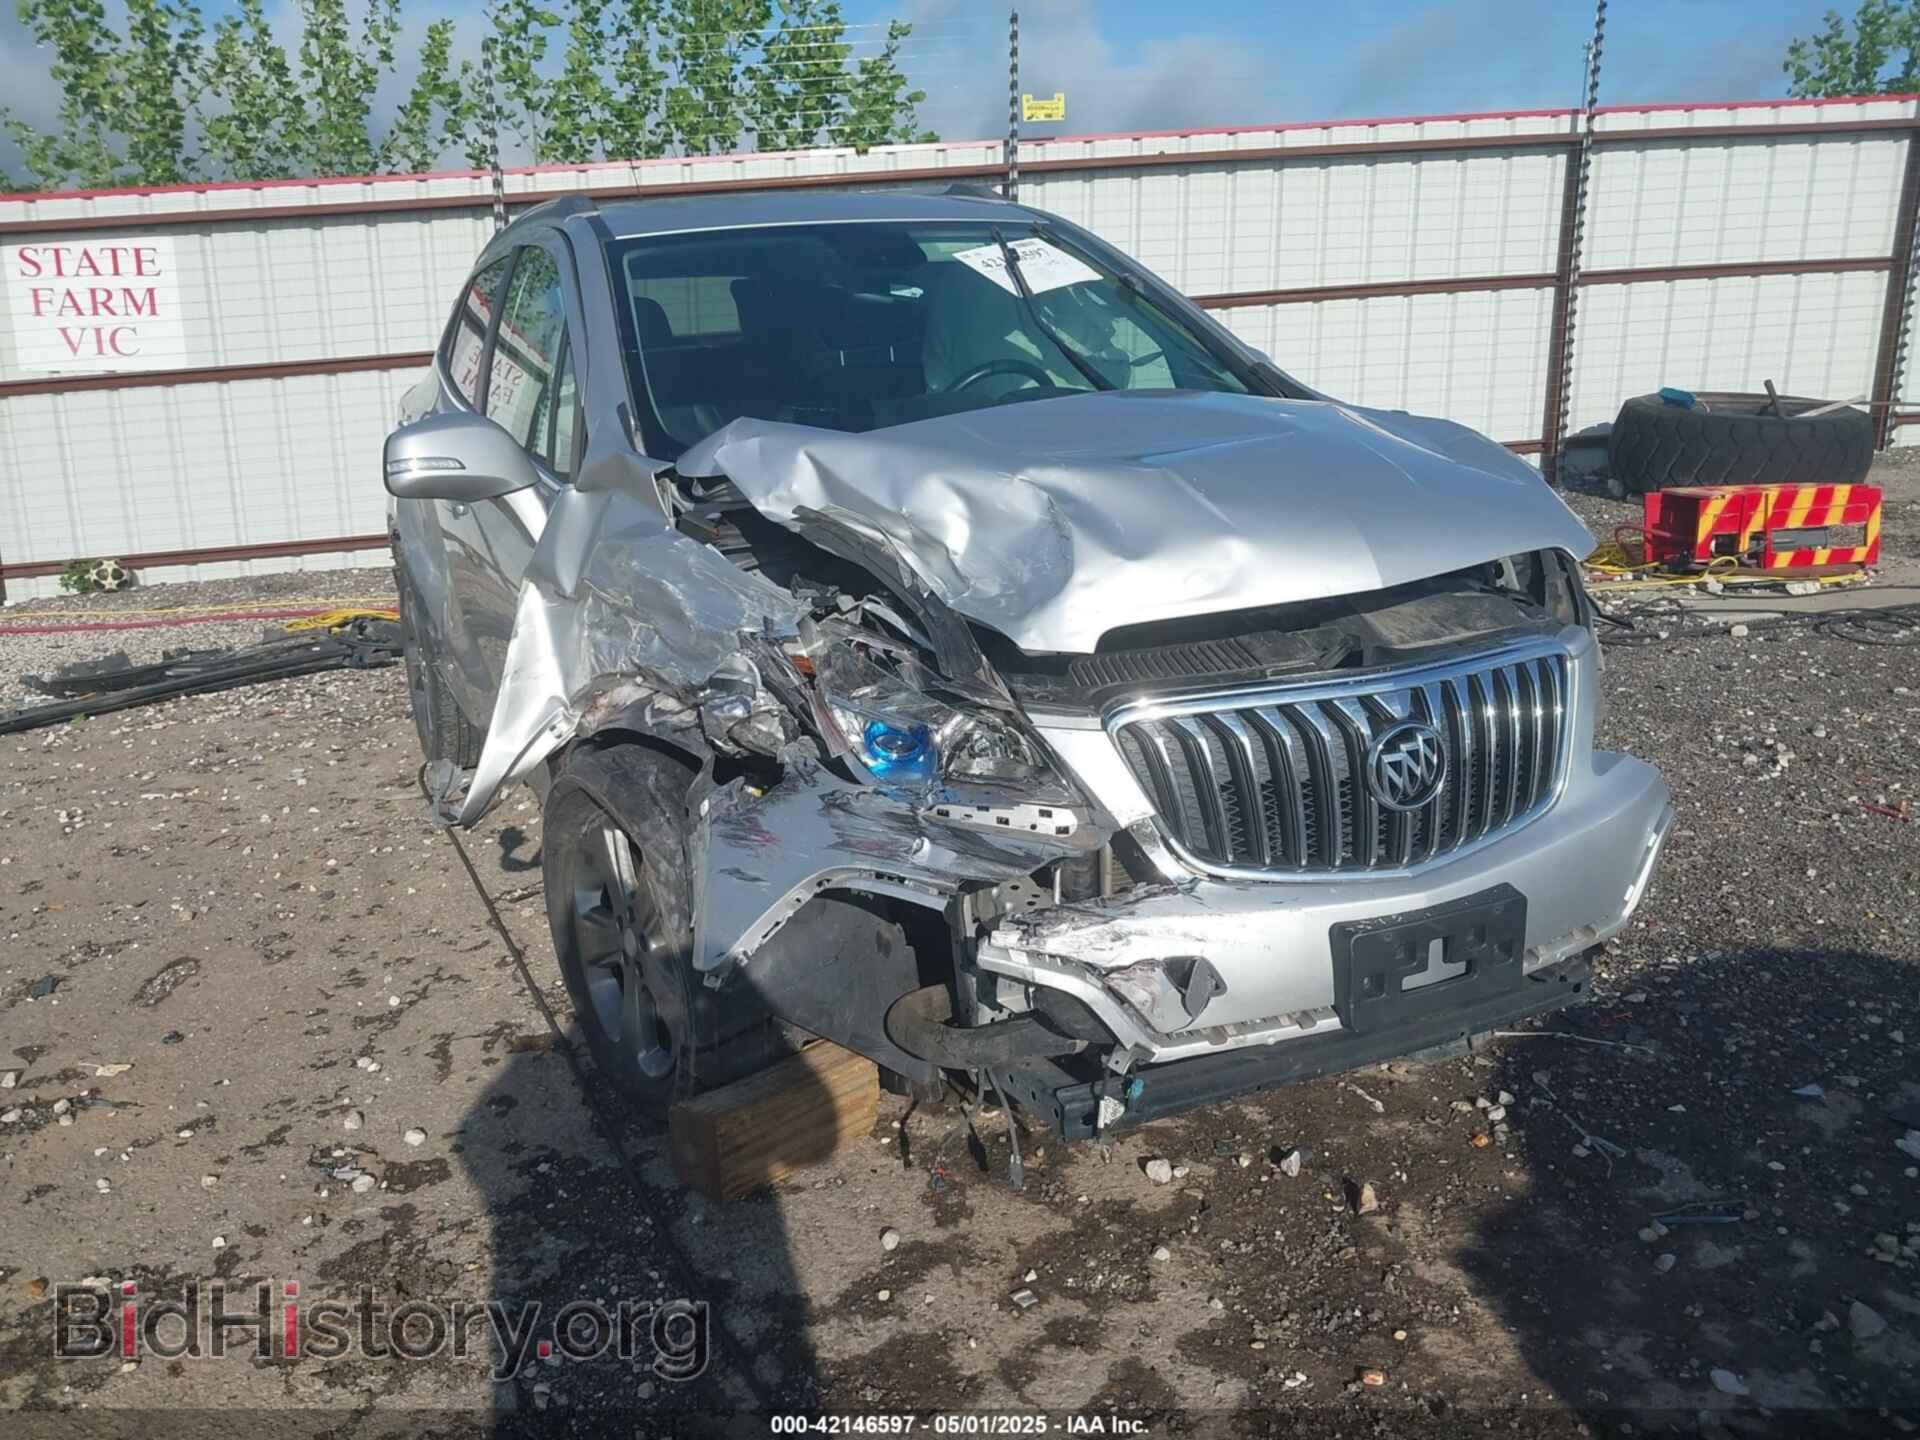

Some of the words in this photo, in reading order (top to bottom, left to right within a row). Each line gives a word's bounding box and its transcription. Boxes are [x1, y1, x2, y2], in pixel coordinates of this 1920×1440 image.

[18, 246, 162, 278] STATE
[28, 287, 161, 317] FARM
[57, 326, 141, 356] VIC
